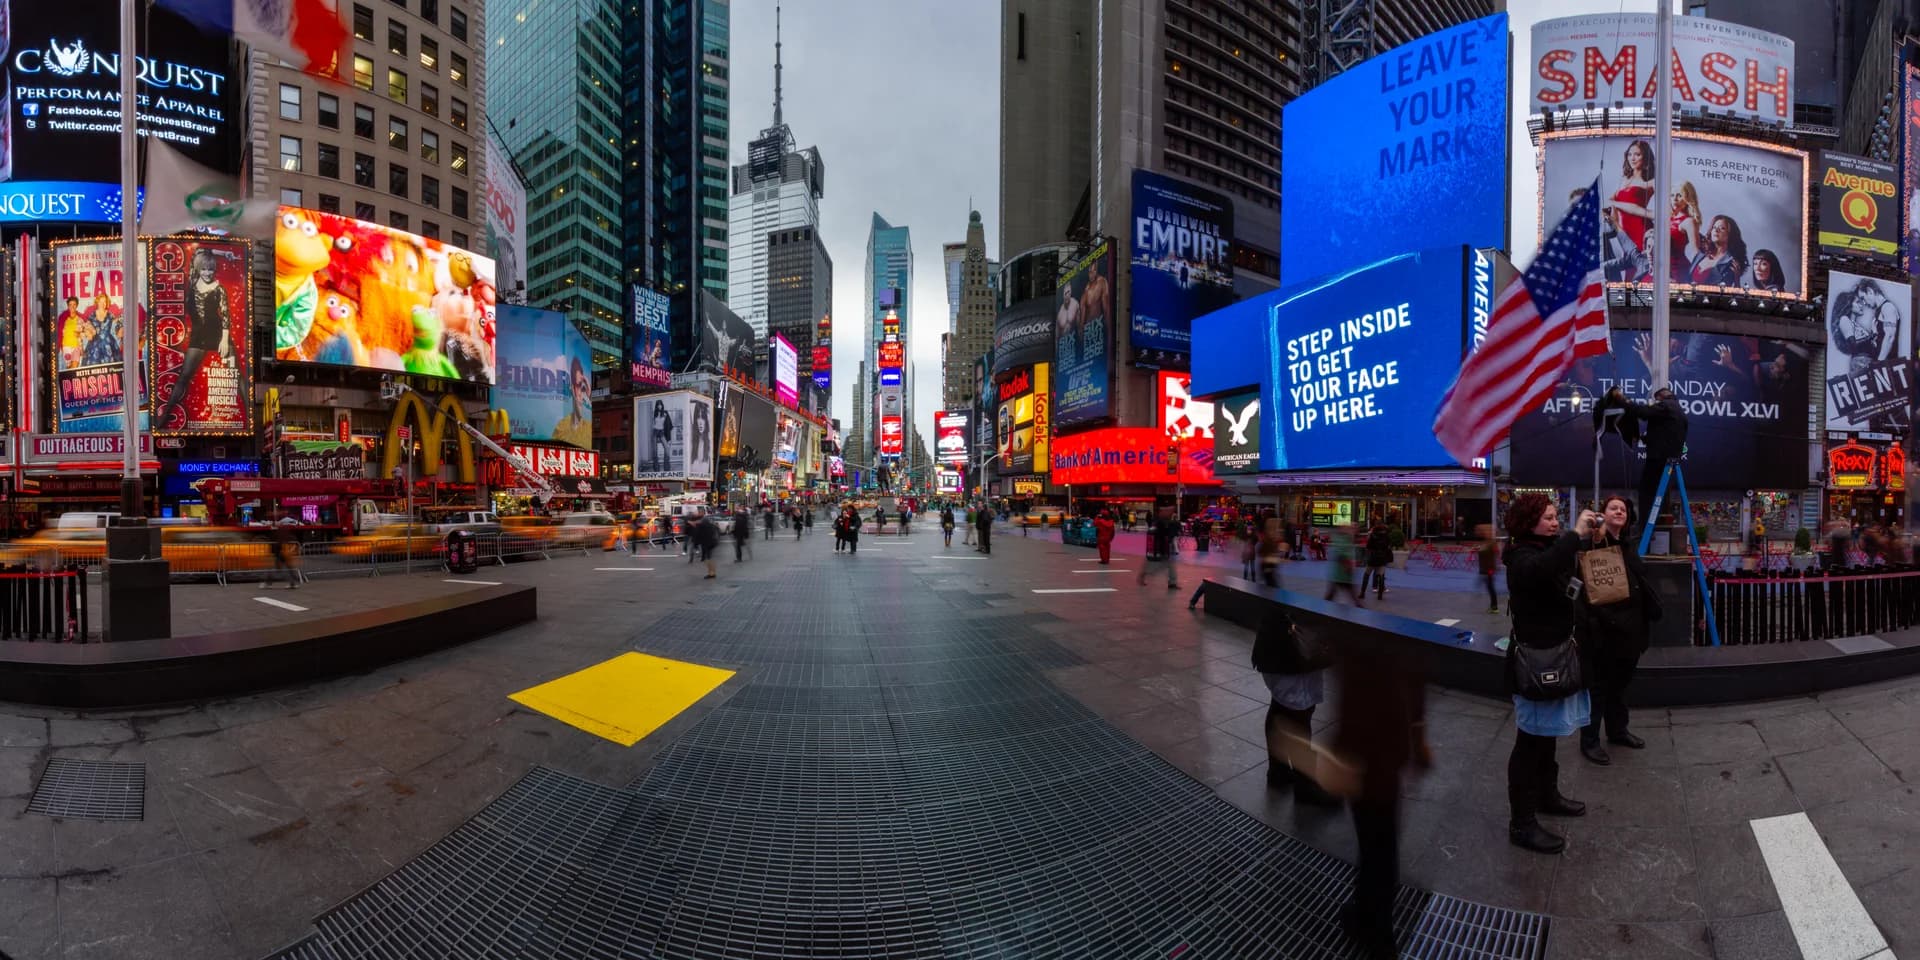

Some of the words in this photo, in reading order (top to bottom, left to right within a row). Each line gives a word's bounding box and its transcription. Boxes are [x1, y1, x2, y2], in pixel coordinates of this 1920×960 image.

[1694, 21, 1731, 34] STEVEN
[1735, 29, 1789, 48] SPIELBERG
[1380, 29, 1479, 95] LEAVE
[1536, 44, 1789, 118] SMASH
[155, 96, 225, 123] APPAREL
[1388, 76, 1477, 133] YOUR
[1378, 124, 1474, 181] MARK
[1686, 156, 1719, 168] STARS
[1720, 160, 1758, 173] AREN'T
[1700, 169, 1743, 183] THEY'RE
[1746, 175, 1779, 189] MADE.
[1824, 167, 1896, 197] Avenue
[1147, 206, 1220, 238] BOARDWALK
[1840, 190, 1878, 235] Q
[1136, 216, 1230, 264] EMPIRE
[62, 269, 123, 299] HEAR
[635, 301, 669, 324] BEST
[635, 315, 669, 334] MUSICAL
[155, 241, 188, 432] CHICAGO
[1287, 328, 1333, 361] STEP
[1340, 302, 1411, 345] INSIDE
[632, 362, 671, 386] MEMPHIS
[1288, 360, 1312, 385] TO
[1317, 346, 1354, 376] GET
[207, 378, 238, 388] RUNNING
[207, 387, 238, 396] AMERICAN
[1000, 369, 1030, 401] Kodak
[1290, 376, 1342, 408] YOUR
[1347, 360, 1399, 394] FACE
[1597, 377, 1637, 395] THE
[1831, 363, 1909, 409] RENT
[64, 400, 89, 408] QUEEN
[207, 395, 238, 406] MUSICAL
[1292, 408, 1317, 432] UP
[1323, 393, 1384, 426] HERE.
[1740, 402, 1780, 420] XLVI
[1034, 392, 1047, 445] Kodak
[40, 437, 113, 454] OUTRAGEOUS
[160, 439, 182, 447] FUEL
[180, 463, 210, 472] MONEY
[288, 459, 324, 472] FRIDAYS
[327, 458, 337, 468] AT
[340, 457, 360, 468] 10PM
[1055, 452, 1078, 469] Bank
[1081, 450, 1092, 466] of
[1093, 446, 1168, 466] Americ
[1243, 452, 1260, 460] EAGLE
[1834, 452, 1871, 471] ROXY
[1591, 566, 1622, 577] brown
[1593, 577, 1614, 587] bag
